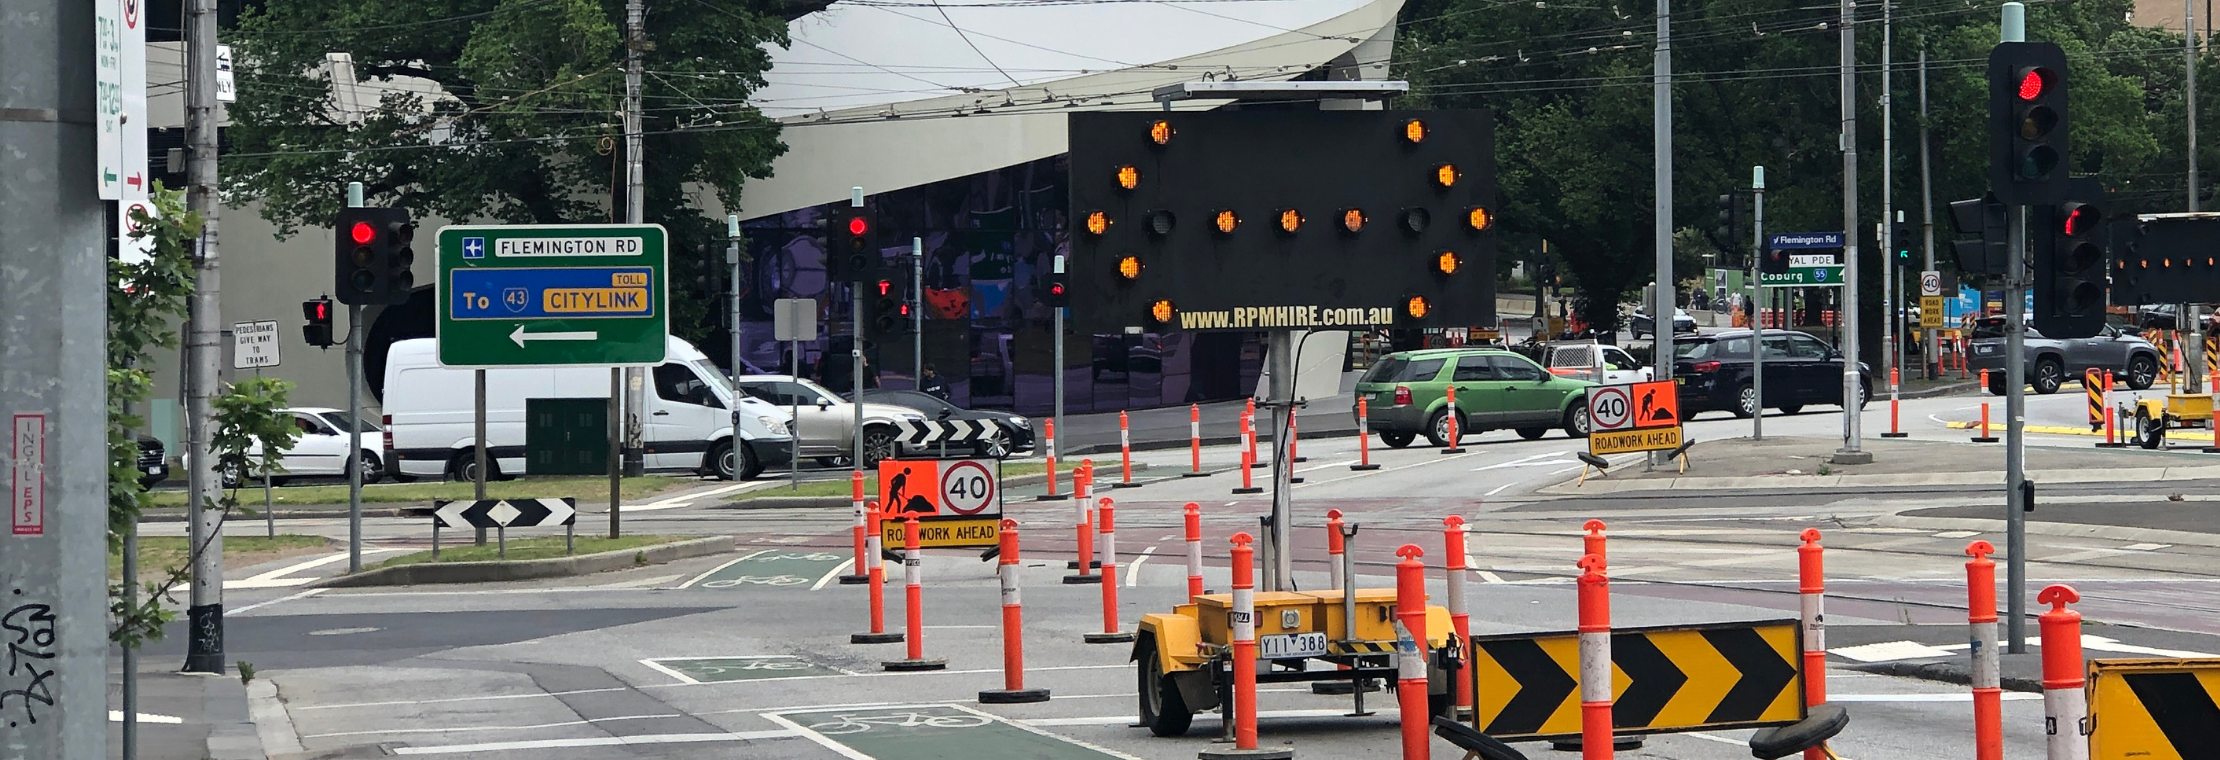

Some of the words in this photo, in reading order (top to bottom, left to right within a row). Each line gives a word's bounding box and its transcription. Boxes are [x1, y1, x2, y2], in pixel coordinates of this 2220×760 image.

[217, 80, 231, 93] NLY
[501, 239, 606, 254] FLEMINGTON
[615, 239, 637, 253] RD
[1781, 236, 1824, 245] Flemington
[1826, 235, 1837, 243] Rd
[1789, 257, 1807, 265] YAL
[1812, 256, 1831, 264] PDE
[617, 275, 643, 285] TOLL
[1761, 273, 1803, 283] Coburg
[1924, 279, 1938, 288] 40
[463, 292, 490, 310] To
[506, 291, 525, 305] 43
[550, 291, 640, 309] CITYLINK
[1180, 306, 1393, 329] www.RPMHIRE.com.au
[240, 336, 254, 345] GIVE
[258, 335, 271, 343] WAY
[253, 346, 261, 354] TO
[246, 356, 269, 365] TRAMS
[1597, 398, 1625, 418] 40
[1595, 434, 1643, 450] ROADWORK
[1647, 432, 1677, 446] AHEAD
[950, 476, 986, 500] 40
[887, 527, 951, 542] ROWORK
[956, 526, 994, 540] AHEAD
[1300, 636, 1325, 652] 388
